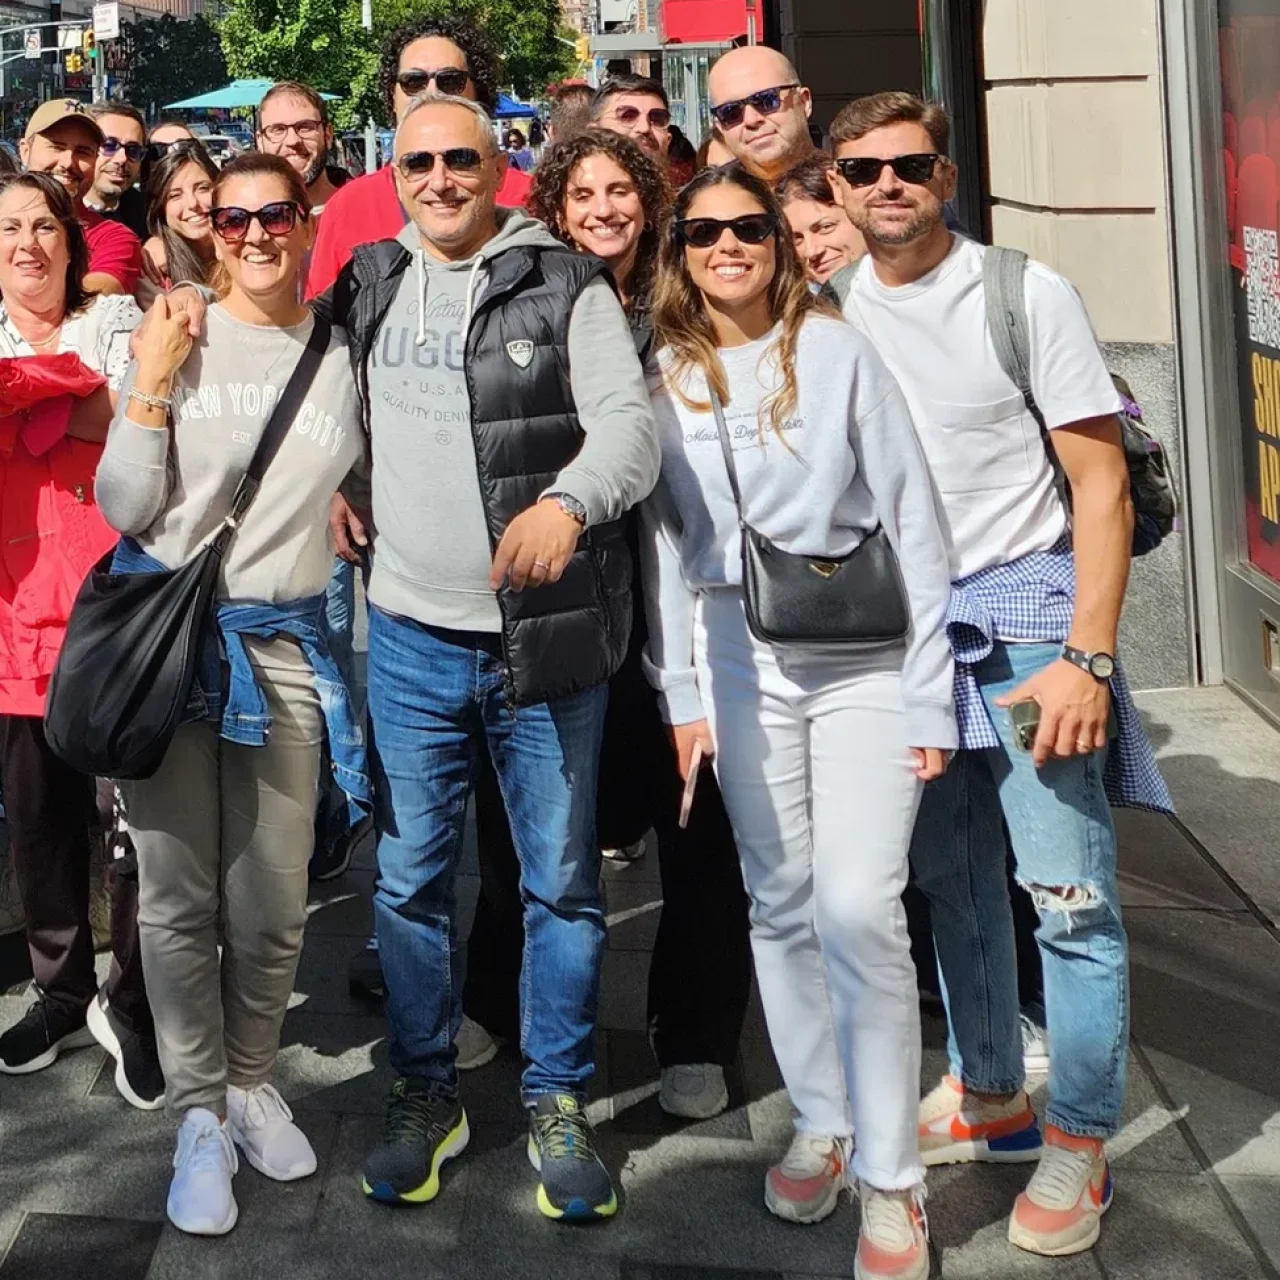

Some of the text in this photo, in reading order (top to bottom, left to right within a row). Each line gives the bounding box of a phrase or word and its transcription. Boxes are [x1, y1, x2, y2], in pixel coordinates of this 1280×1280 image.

[407, 292, 466, 325] Vintag
[171, 383, 346, 457] NEW YOR CITY
[383, 391, 430, 420] QUALITY
